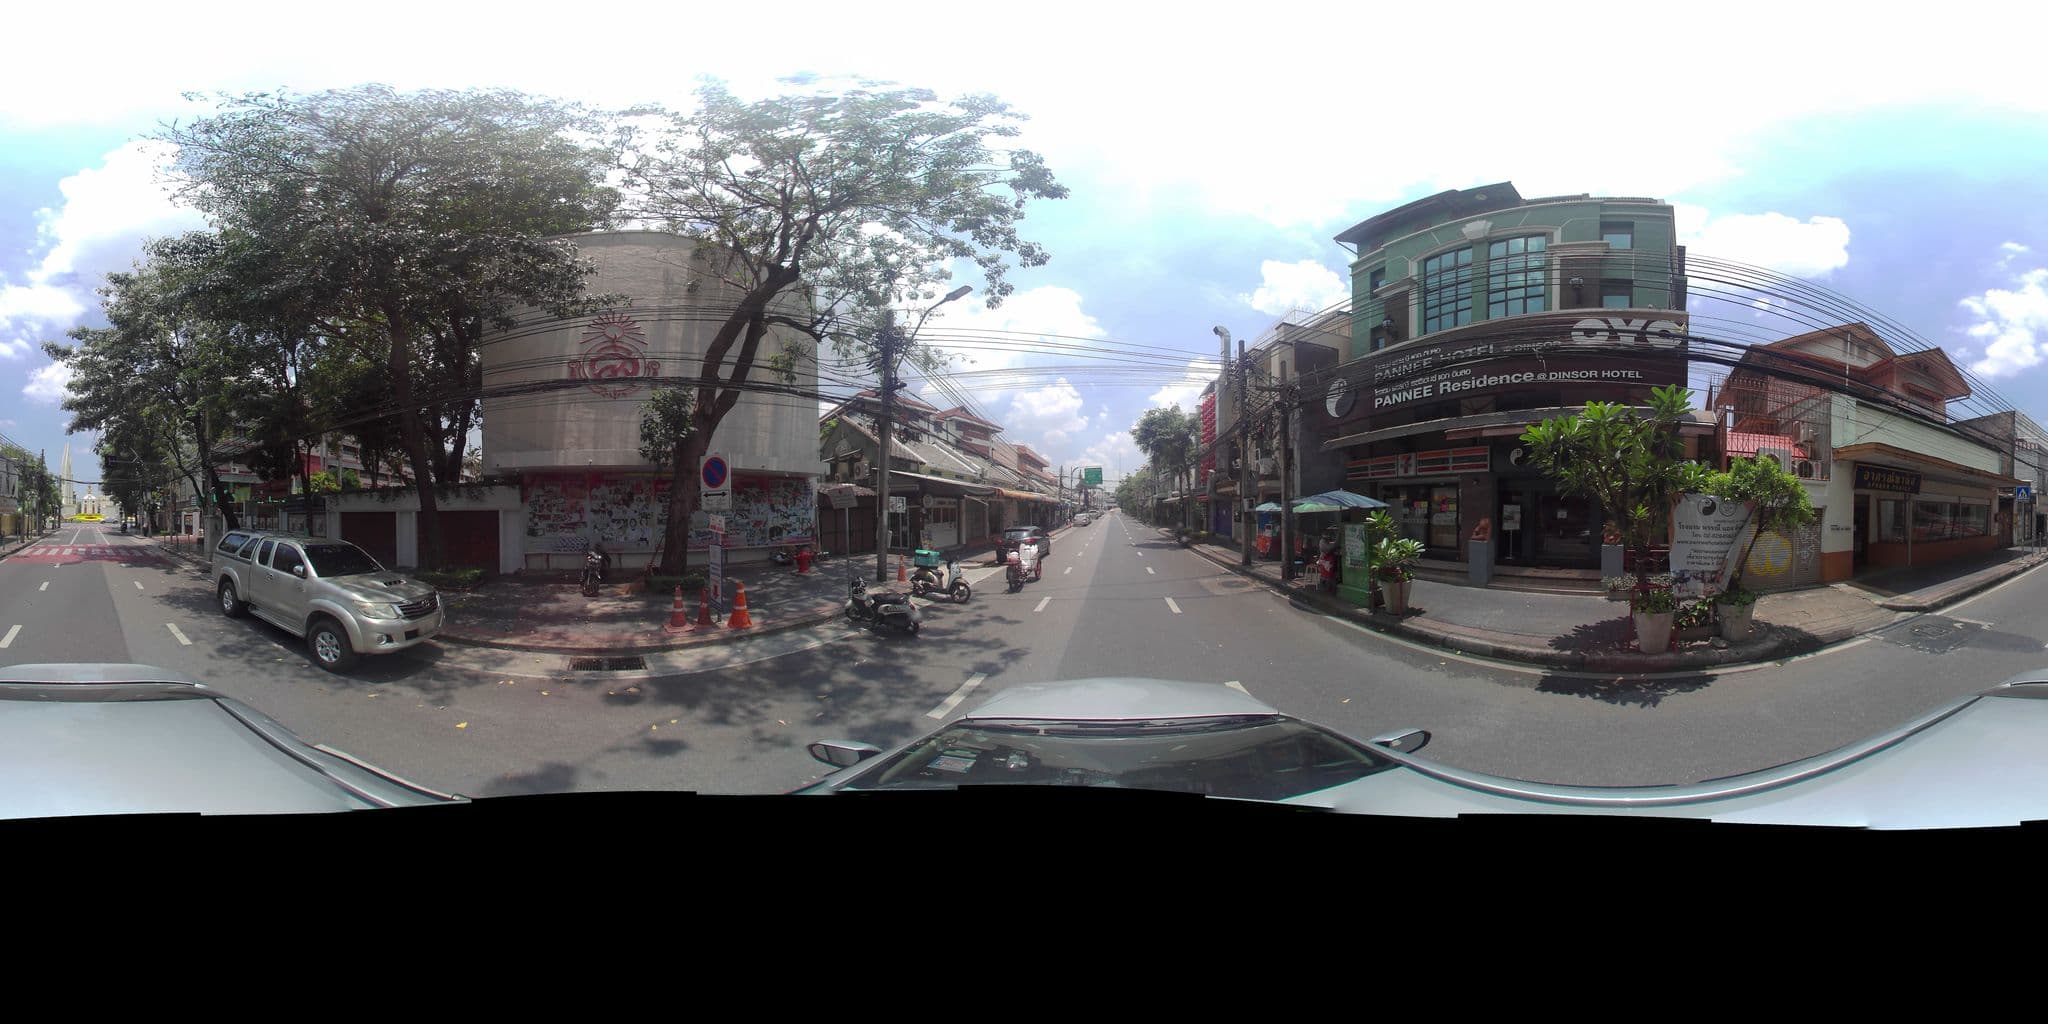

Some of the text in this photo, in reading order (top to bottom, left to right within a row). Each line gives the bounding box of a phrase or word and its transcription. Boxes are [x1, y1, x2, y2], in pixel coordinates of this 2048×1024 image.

[1375, 384, 1433, 409] PANNEE
[1439, 371, 1535, 395] Residence
[1549, 370, 1598, 380] DINSOR
[1601, 369, 1643, 380] HOTEL
